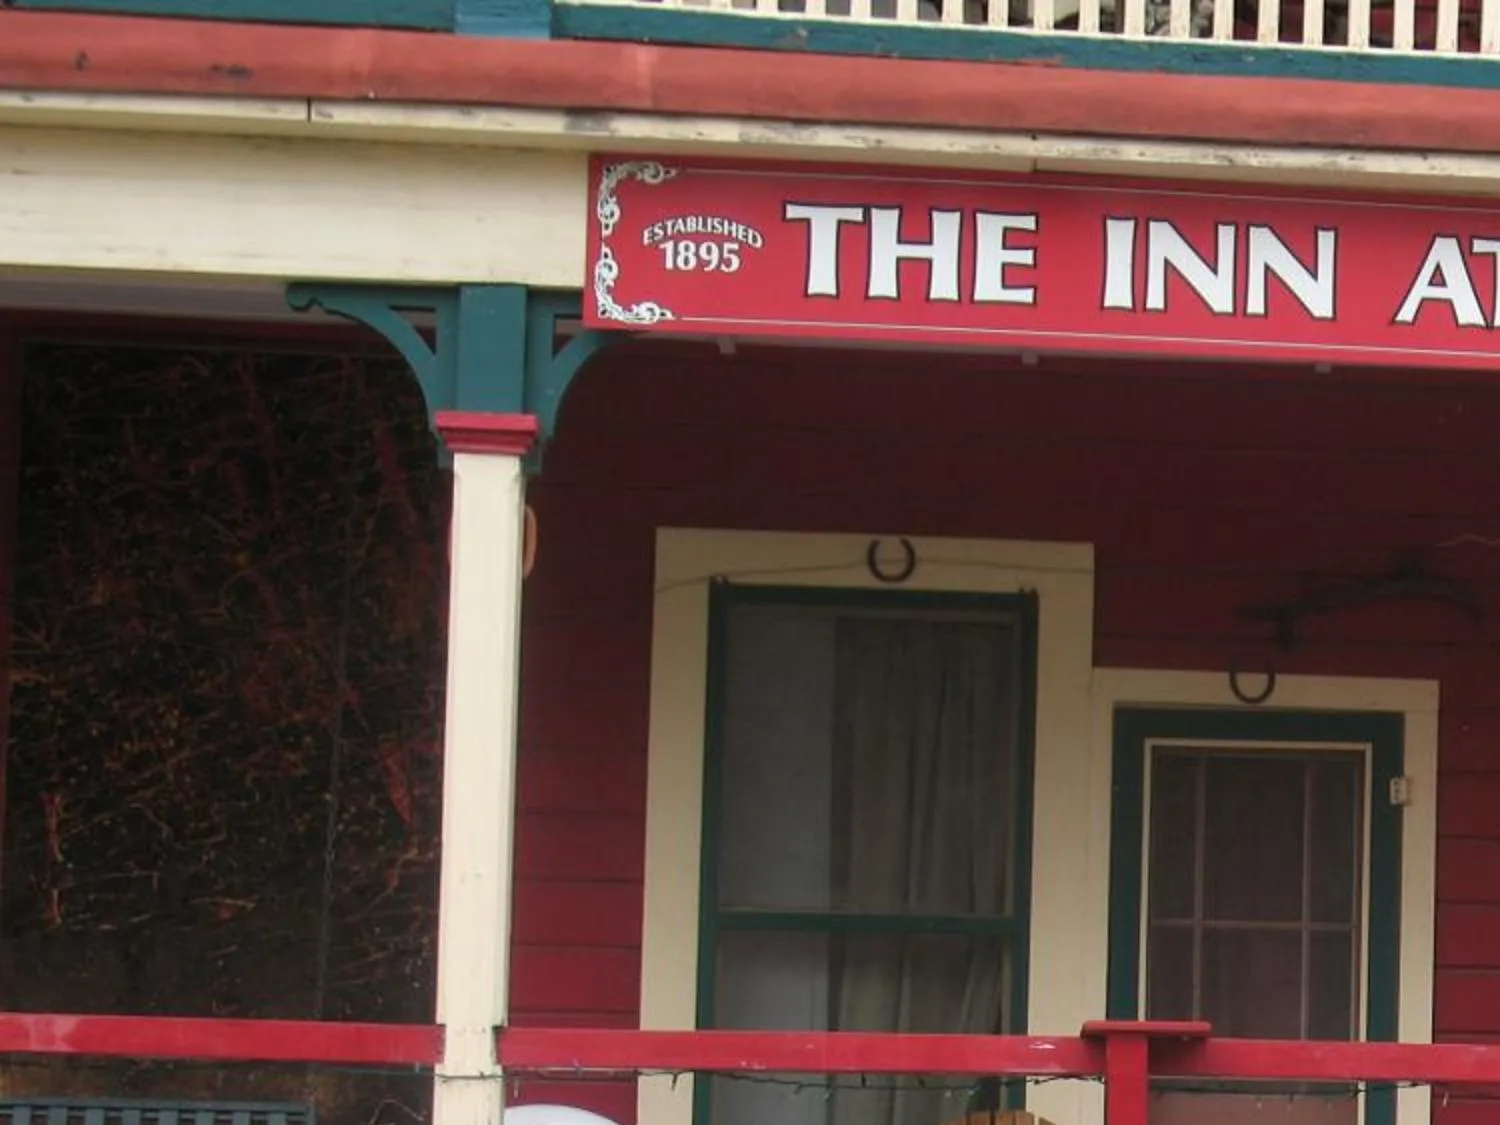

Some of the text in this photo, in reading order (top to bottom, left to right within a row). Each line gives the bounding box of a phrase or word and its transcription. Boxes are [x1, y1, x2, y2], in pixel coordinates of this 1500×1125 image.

[642, 215, 764, 249] ESTABLISHED
[659, 240, 742, 274] 1895
[783, 201, 1039, 306] THE
[1100, 213, 1339, 321] INN
